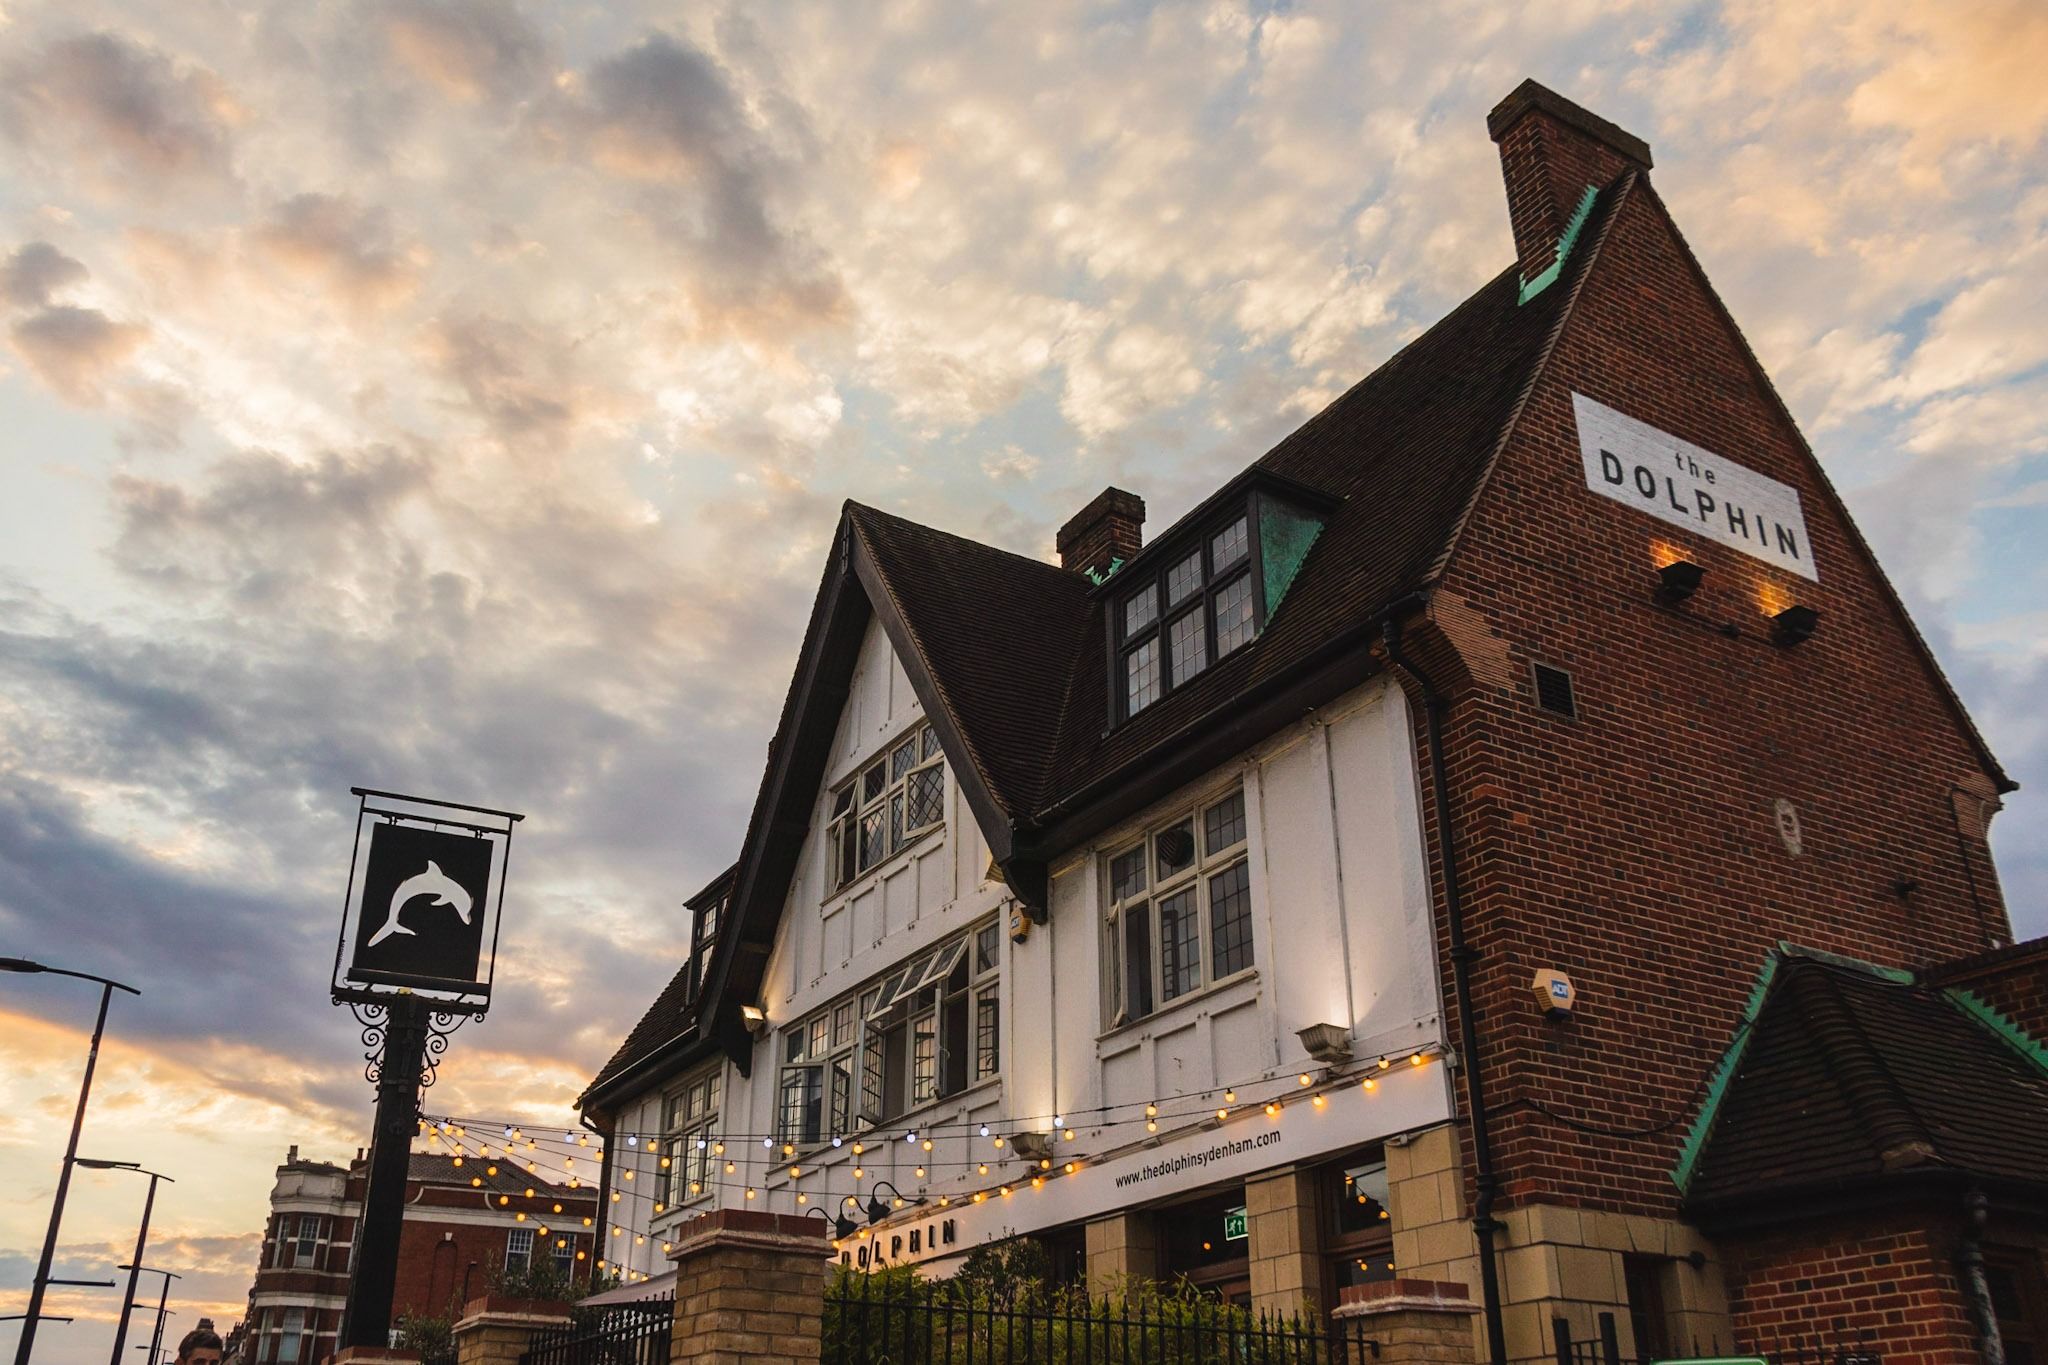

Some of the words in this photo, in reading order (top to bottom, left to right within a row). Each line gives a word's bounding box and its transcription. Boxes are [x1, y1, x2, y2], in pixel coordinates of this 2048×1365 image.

[1675, 452, 1716, 484] the
[1600, 448, 1800, 559] DOLPHIN
[1115, 1130, 1281, 1188] www.thedolphinsydenham.com
